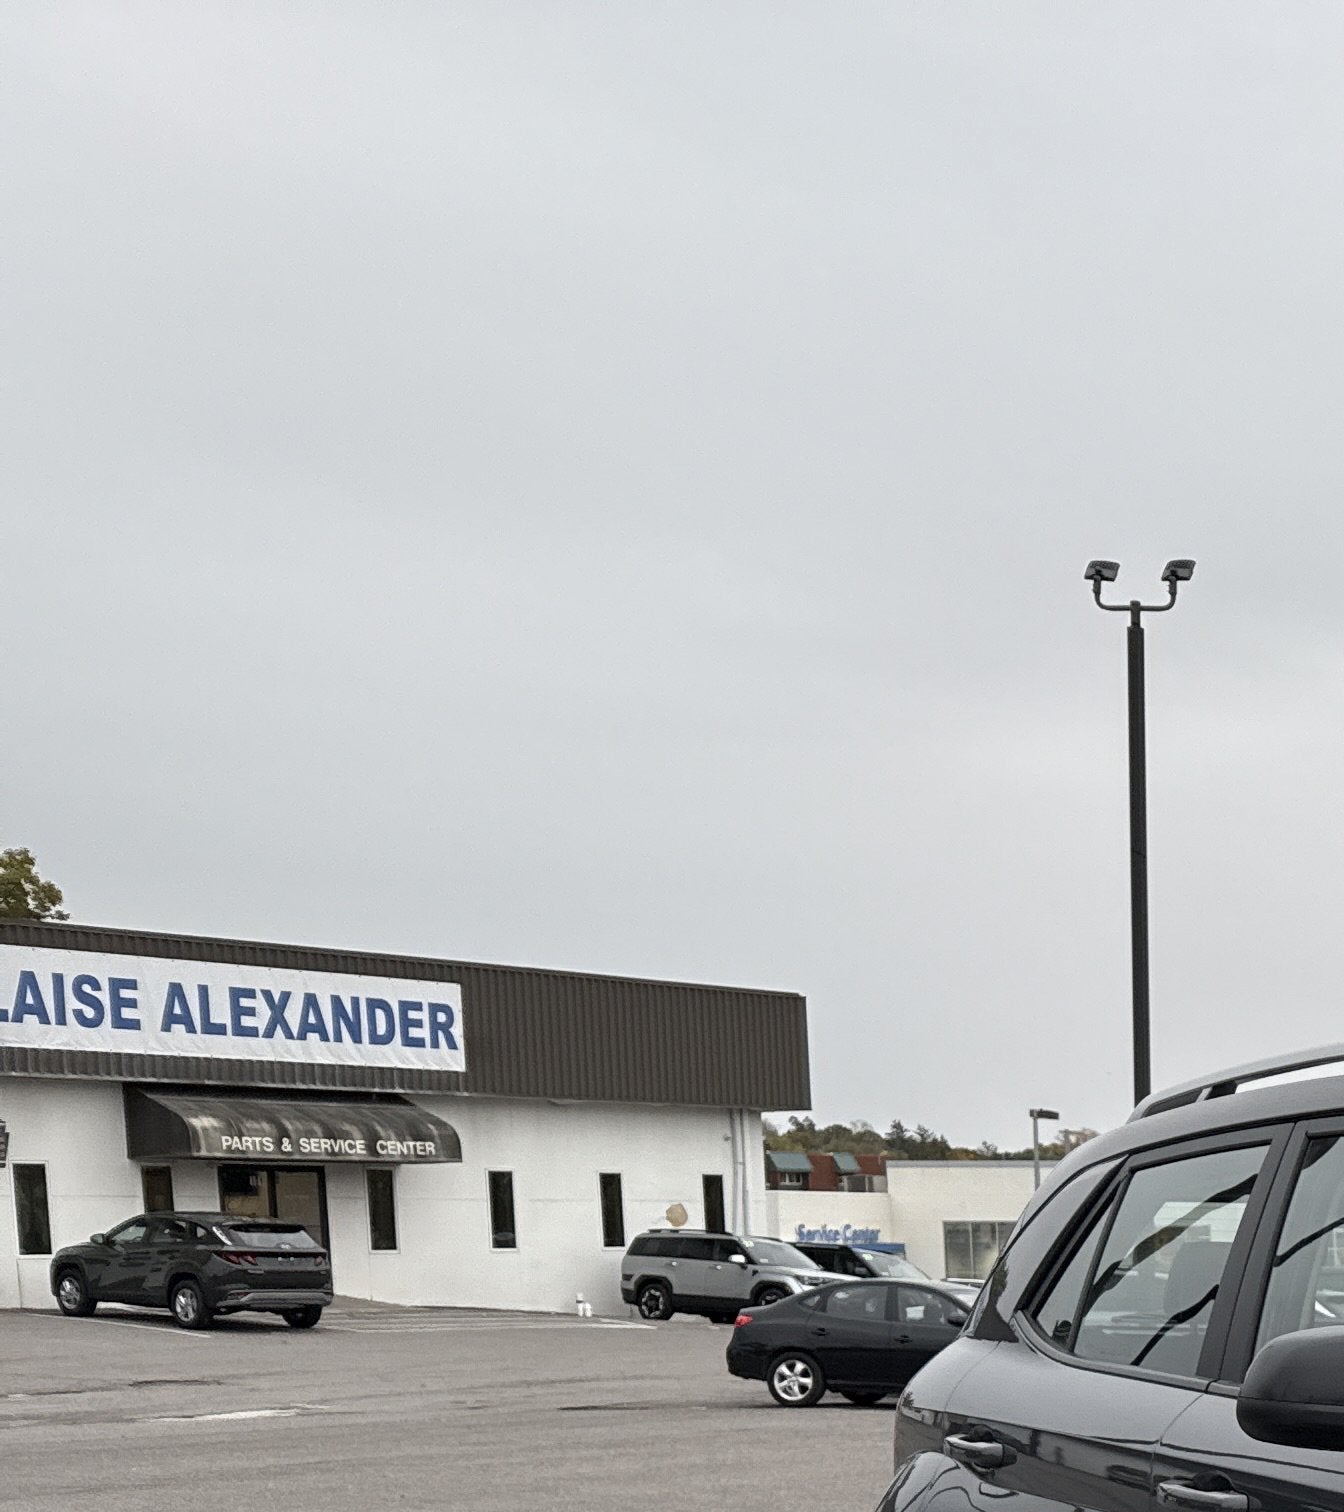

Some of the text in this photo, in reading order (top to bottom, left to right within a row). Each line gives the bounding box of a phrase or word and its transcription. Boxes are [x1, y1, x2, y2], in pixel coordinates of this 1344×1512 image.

[0, 969, 459, 1050] AISE ALEXANDER
[221, 1135, 436, 1156] PARTS & SERVICE CENTER
[795, 1223, 881, 1242] Service Center
